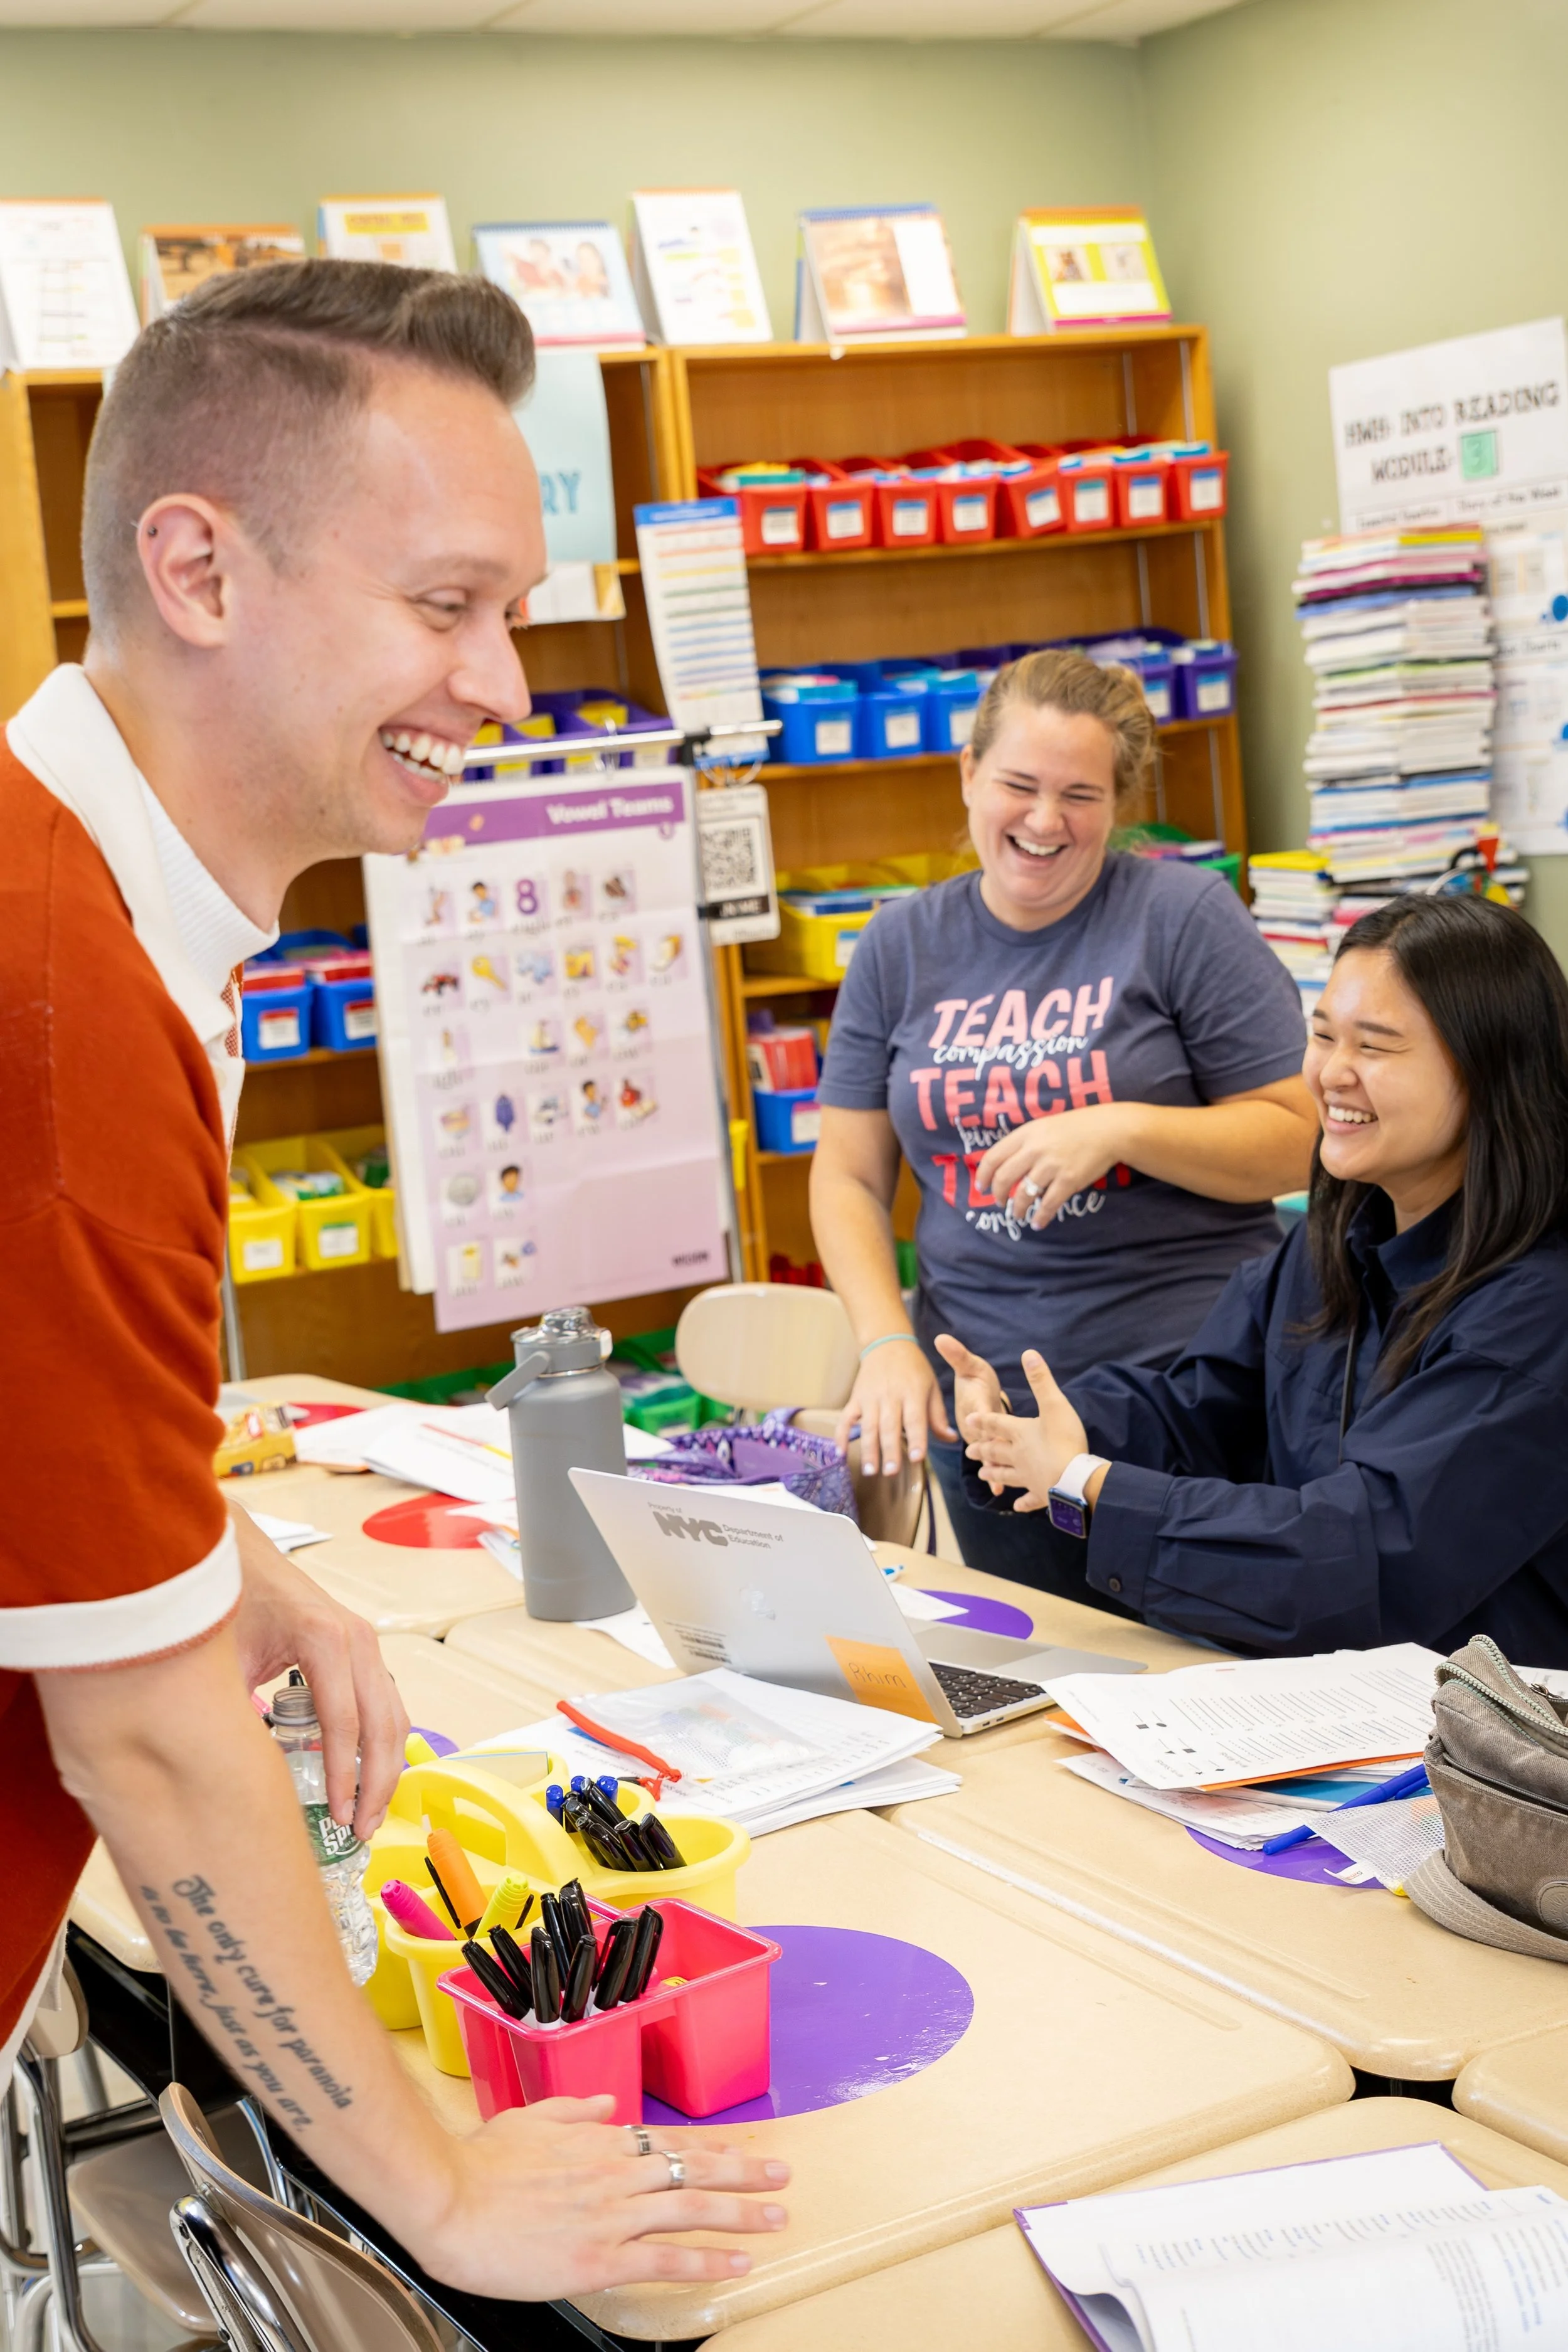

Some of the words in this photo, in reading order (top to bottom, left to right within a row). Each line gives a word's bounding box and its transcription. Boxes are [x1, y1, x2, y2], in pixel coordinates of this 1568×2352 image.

[1401, 405, 1445, 436] INTO
[1453, 381, 1560, 425] READING
[545, 800, 608, 825] Vowel
[609, 795, 674, 818] Teams
[928, 977, 1114, 1049] TEACH
[933, 1034, 1089, 1081] compassion
[910, 1051, 1113, 1131] TEACH
[653, 1511, 728, 1547] NYC
[723, 1524, 773, 1541] Department
[728, 1534, 771, 1549] Education
[848, 1662, 907, 1688] Rhim
[172, 1874, 216, 1917] The
[206, 1920, 246, 1964] only
[237, 1964, 275, 2005] cure
[253, 2005, 299, 2033] for
[235, 2037, 260, 2058] as
[243, 2060, 284, 2094] you
[278, 2037, 353, 2109] paranoia
